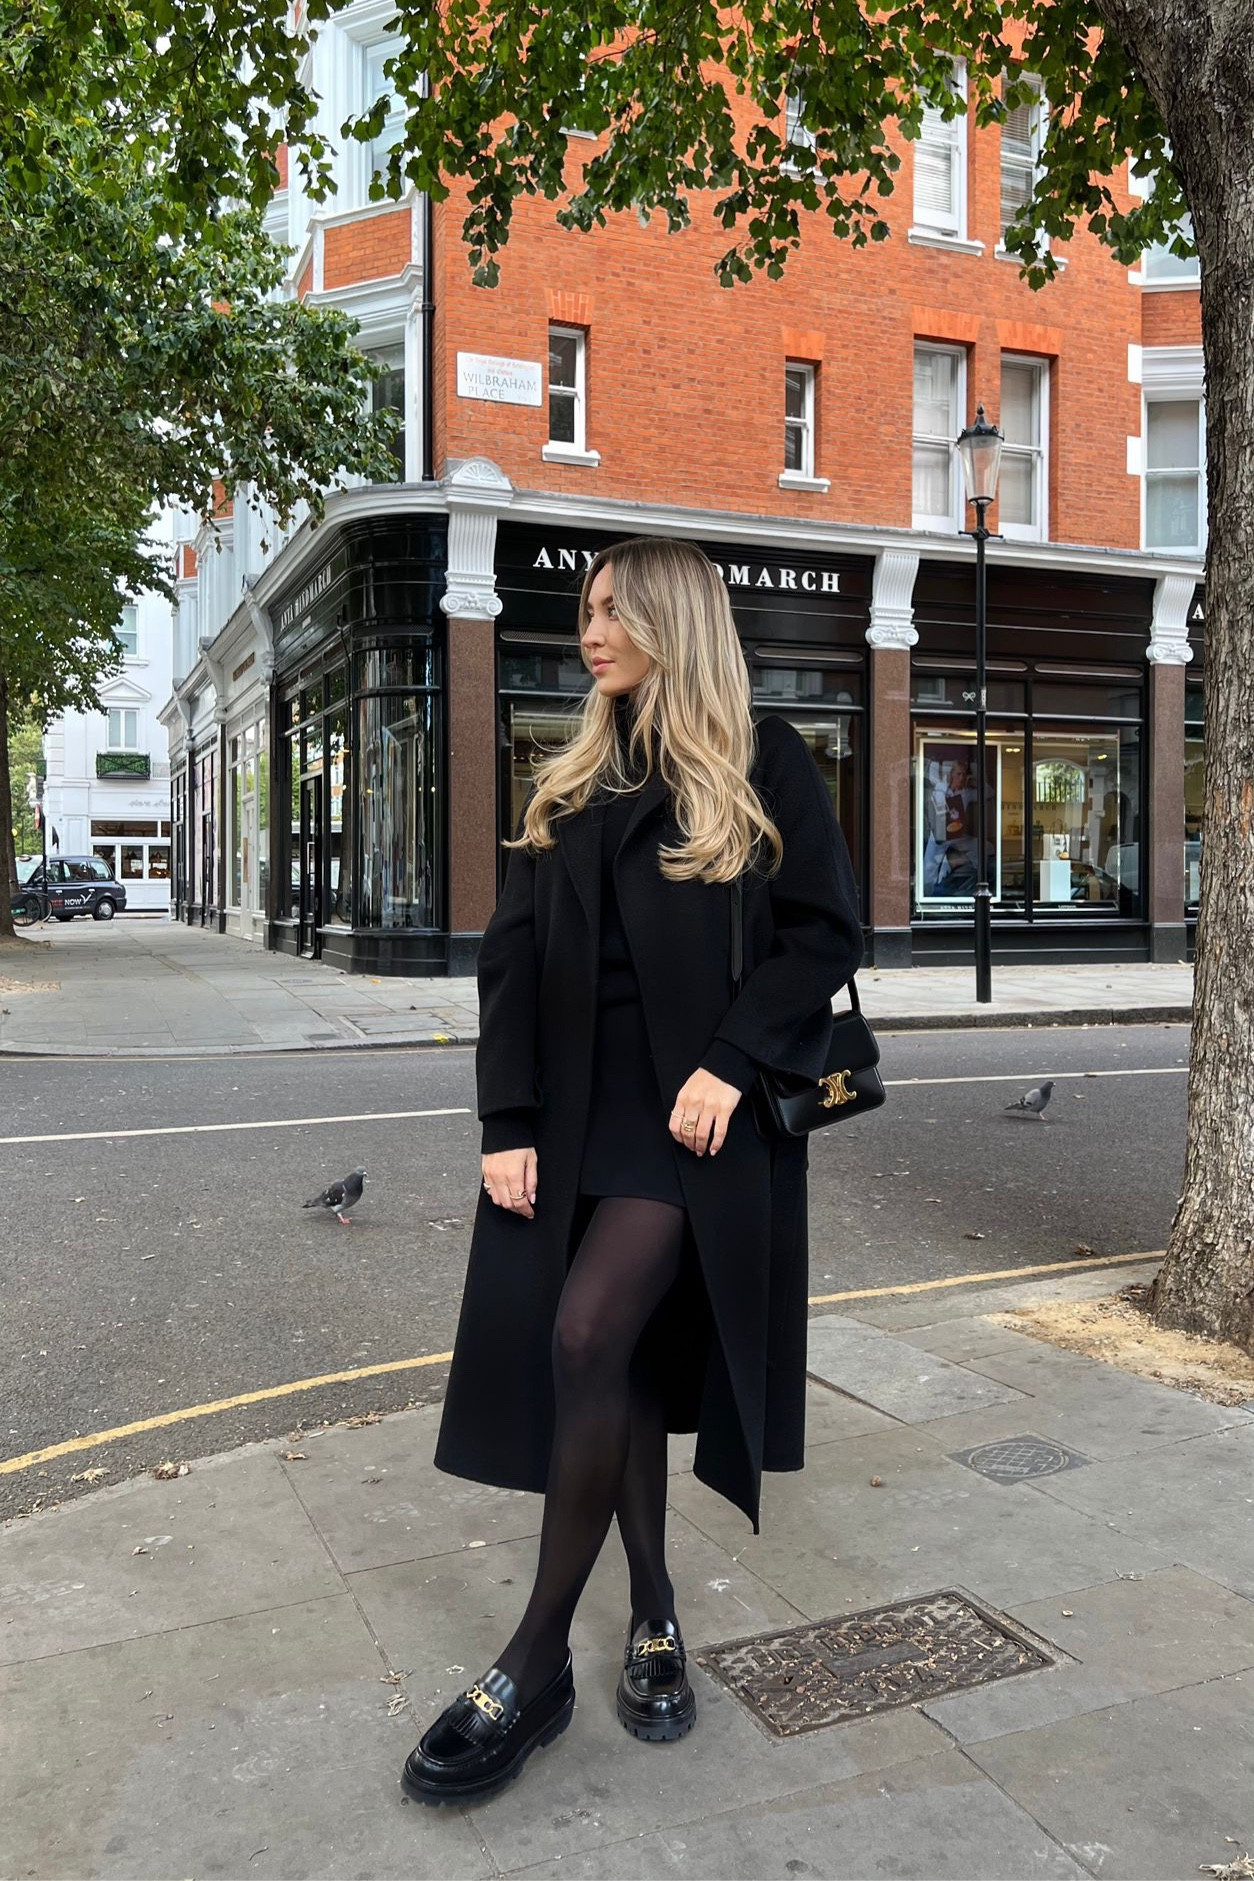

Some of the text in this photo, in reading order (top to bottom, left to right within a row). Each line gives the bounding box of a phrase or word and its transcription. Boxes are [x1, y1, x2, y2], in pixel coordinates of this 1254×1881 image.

[463, 371, 538, 392] WILBRAHAM
[468, 385, 505, 400] PLACE
[532, 546, 600, 572] ANY
[64, 898, 82, 906] NOW
